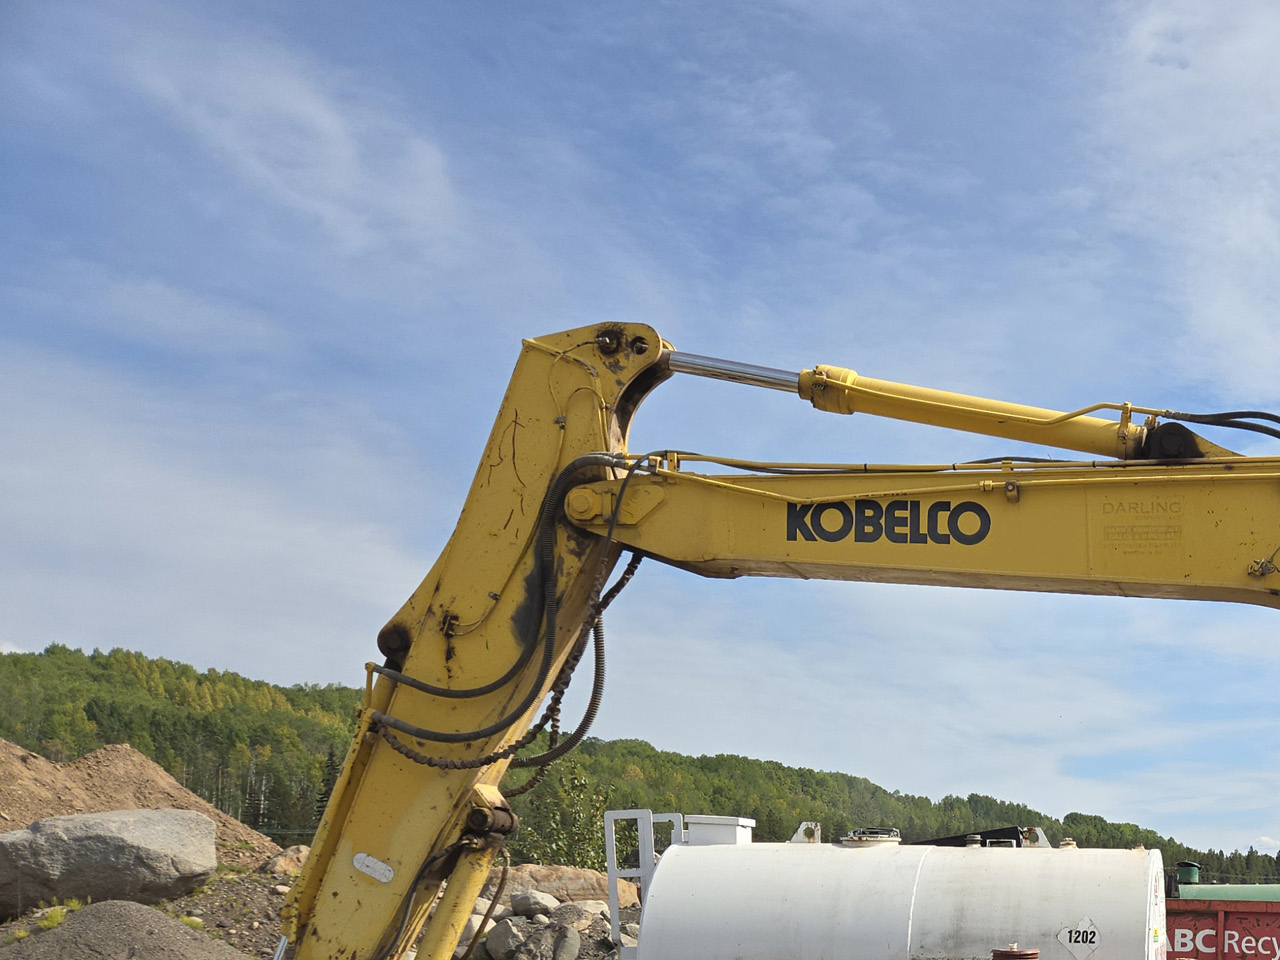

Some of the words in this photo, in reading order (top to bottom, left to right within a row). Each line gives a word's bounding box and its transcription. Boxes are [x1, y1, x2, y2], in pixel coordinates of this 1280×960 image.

[1103, 502, 1182, 514] DARLING
[786, 499, 992, 545] KOBELCO
[1067, 929, 1097, 944] 1202
